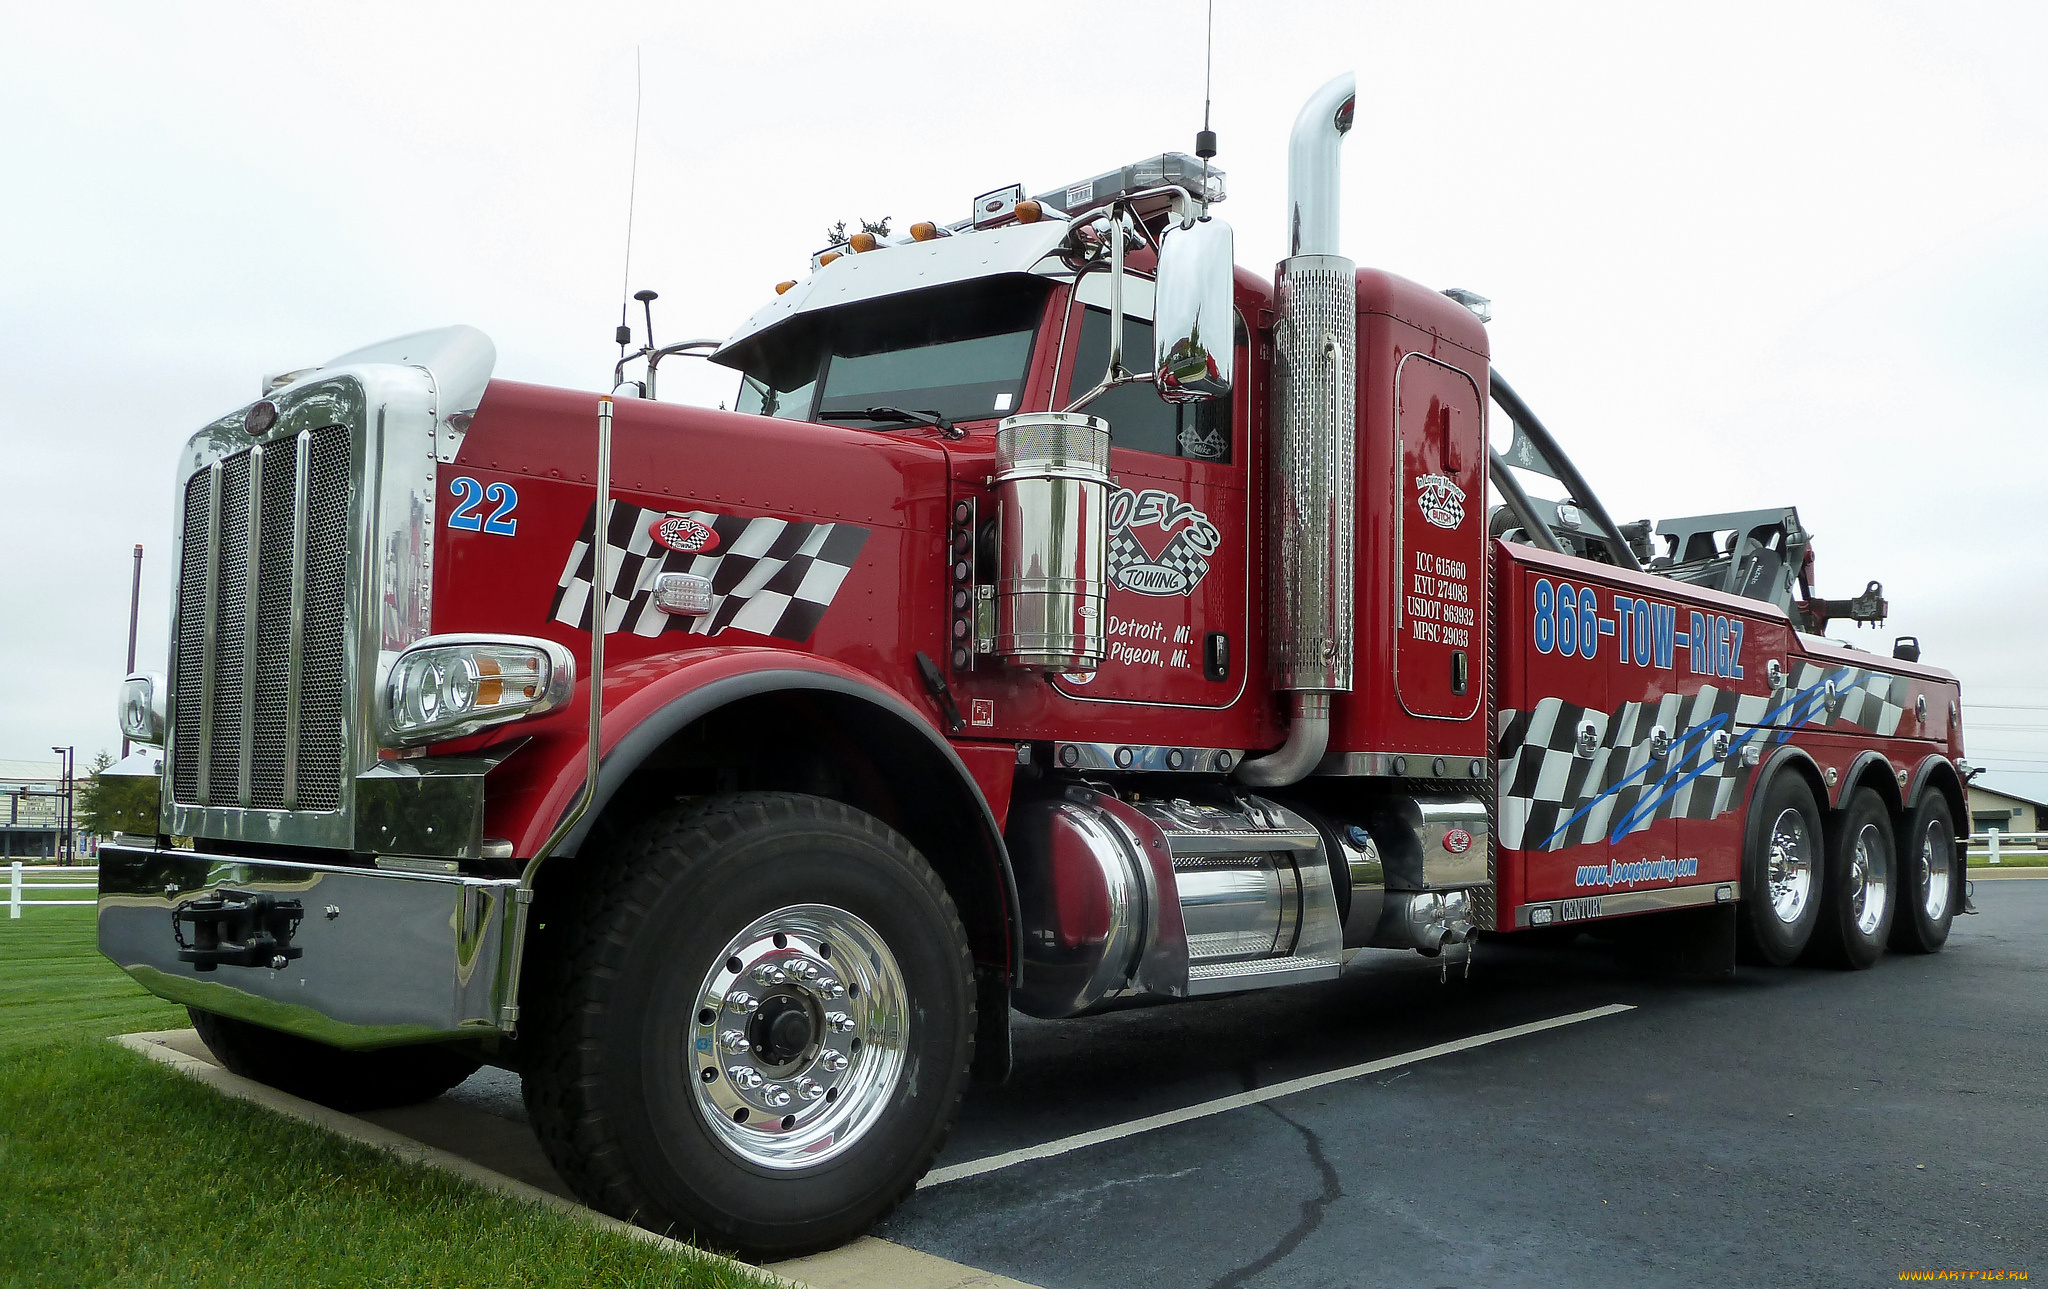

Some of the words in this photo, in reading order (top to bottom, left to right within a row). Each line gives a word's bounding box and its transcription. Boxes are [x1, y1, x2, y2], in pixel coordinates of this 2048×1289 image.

[447, 475, 519, 537] 22
[1432, 509, 1452, 524] BUTCH
[1109, 488, 1221, 556] OEY'S
[674, 541, 695, 549] TOWING
[1125, 569, 1180, 589] TOWING
[1415, 551, 1434, 573] ICC
[1435, 558, 1467, 581] 615660
[1413, 573, 1436, 596] KYU
[1437, 580, 1469, 603] 274083
[1407, 595, 1442, 621] USDOT
[1443, 602, 1475, 626] 863932
[1108, 615, 1167, 644] Detroit,
[1173, 625, 1195, 645] Mi.
[1412, 620, 1441, 643] MPSC
[1442, 626, 1469, 648] 29033
[1534, 578, 1744, 680] 866-TOW-RIGZ
[1110, 641, 1165, 668] Pigeon,
[1170, 649, 1192, 669] Mi.
[1575, 855, 1698, 888] www.joeystowing.com
[1561, 896, 1604, 922] CENTURY
